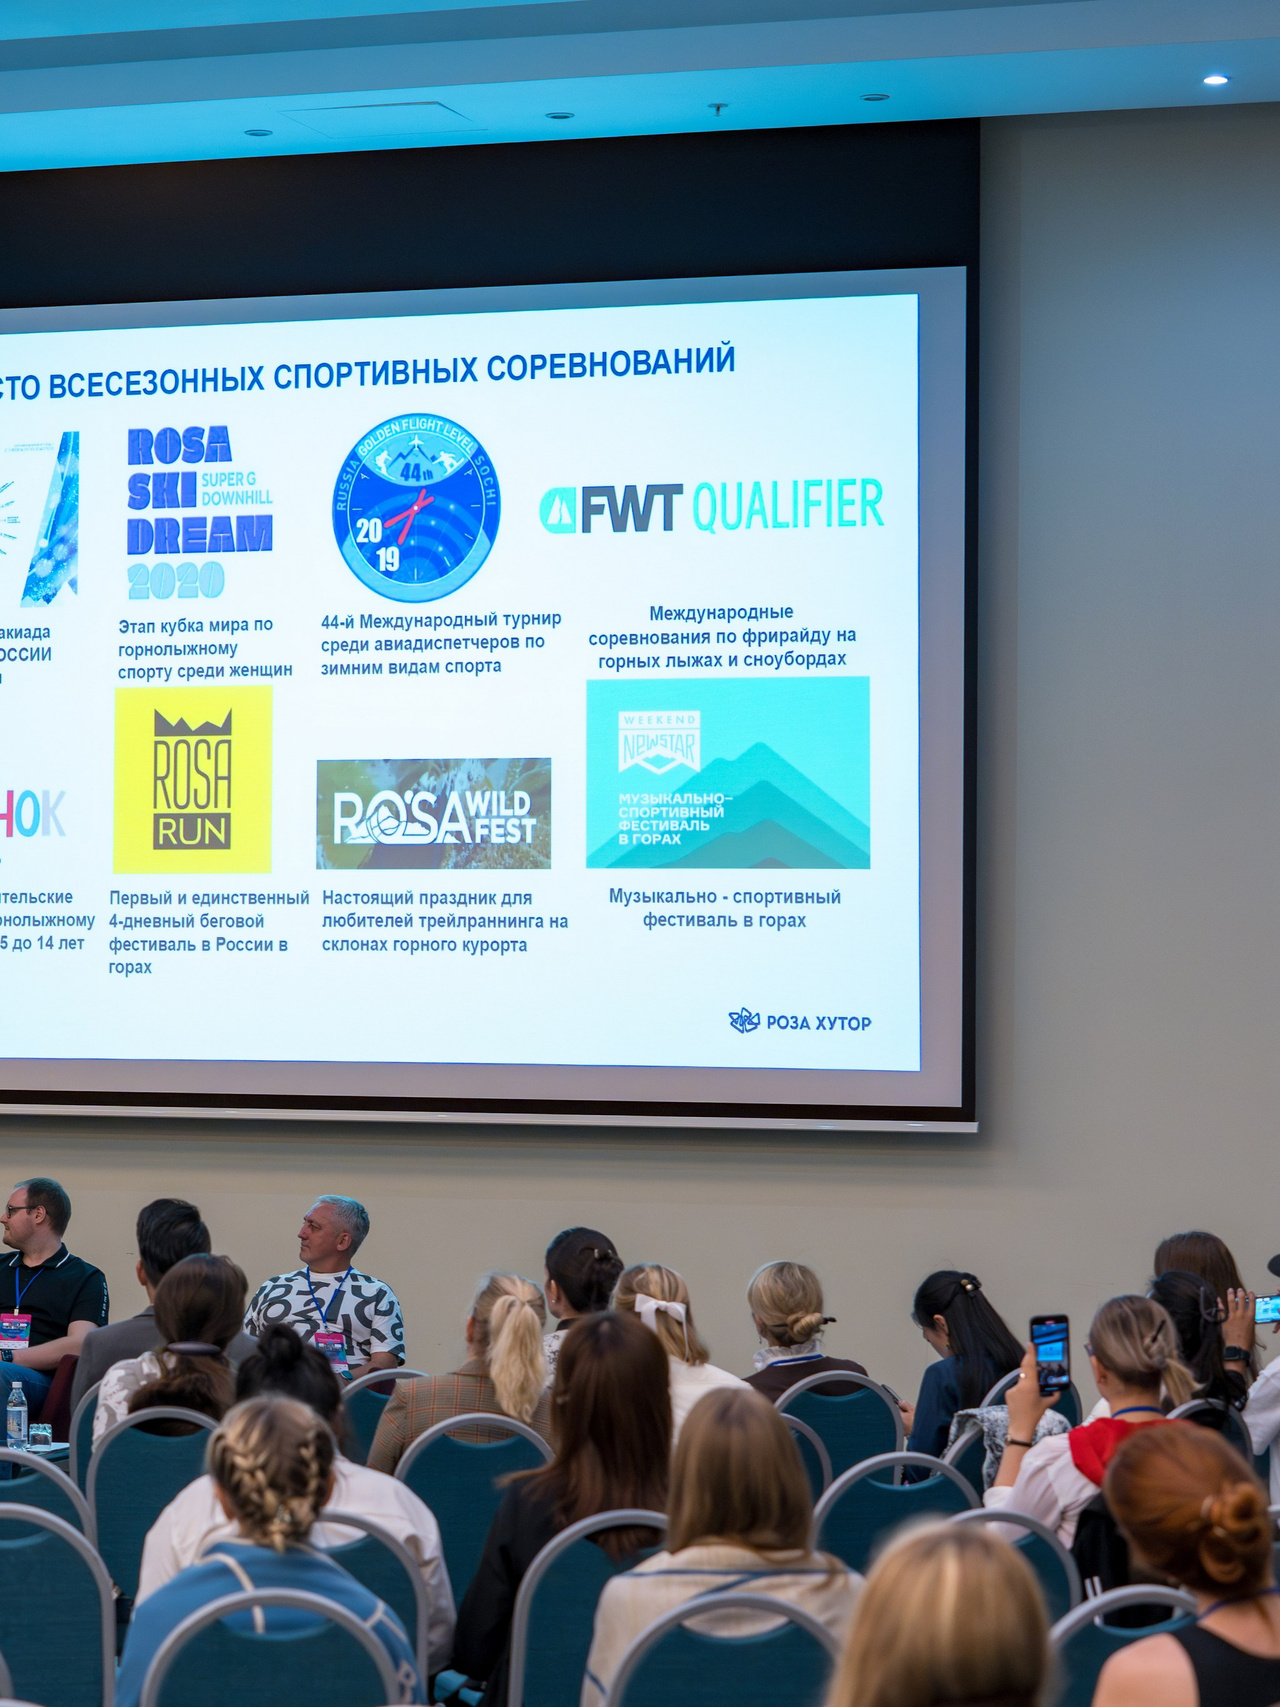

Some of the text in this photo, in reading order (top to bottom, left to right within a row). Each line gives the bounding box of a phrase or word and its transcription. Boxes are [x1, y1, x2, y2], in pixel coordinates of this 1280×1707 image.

[50, 365, 265, 399] ВСЕСЕЗОННЫХ
[274, 357, 478, 389] СПОРТИВНЫХ
[487, 340, 735, 381] СОРЕВНОВАНИЙ
[128, 425, 233, 465] ROSA
[358, 417, 475, 456] GOLDEN FLIGHT LEVEL
[202, 471, 256, 487] SUPER G
[336, 460, 360, 511] RUSSIA
[475, 455, 496, 505] SOCHI
[127, 471, 197, 510] SKI
[202, 490, 273, 506] DOWNHILL
[582, 478, 885, 534] FWT QUALIFIER
[127, 514, 273, 555] DREAM
[356, 518, 382, 543] 20
[376, 546, 400, 572] 19
[127, 561, 225, 600] 2020
[321, 612, 562, 632] 44-й Международный турнир
[650, 606, 794, 624] Международные
[119, 617, 273, 637] Этап кубка мира по
[321, 637, 545, 656] среди авиадиспетчеров по
[589, 627, 856, 650] соревнования по фрирайду на
[119, 643, 238, 660] горнолыжному
[599, 650, 846, 673] горных лыжах и сноубордах
[118, 665, 293, 682] спорту среди женщин
[321, 661, 501, 677] зимним видам спорта
[624, 715, 695, 724] WEEKEND
[153, 739, 232, 810] ROSA
[465, 790, 531, 816] WILD
[619, 805, 724, 818] СПОРТИВНЫЙ
[159, 818, 225, 845] RUN
[475, 818, 537, 844] FEST
[619, 820, 710, 831] ФЕСТИВАЛЬ
[619, 833, 681, 845] В ГОРАХ
[110, 890, 309, 909] Первый и единственный
[323, 890, 532, 909] Настоящий праздник для
[610, 888, 717, 907] Музыкально
[733, 889, 841, 908] спортивный
[109, 913, 264, 930] 4-дневный беговой
[322, 912, 568, 932] любителей трейлраннинга на
[643, 911, 806, 932] фестиваль в горах
[0, 935, 8, 950] 5
[12, 938, 32, 952] до
[37, 935, 54, 950] 14
[58, 938, 85, 950] лет
[109, 937, 288, 955] фестиваль в России в
[322, 939, 527, 956] склонах горного курорта
[109, 962, 152, 978] горах
[767, 1015, 872, 1031] РОЗА ХУТОР
